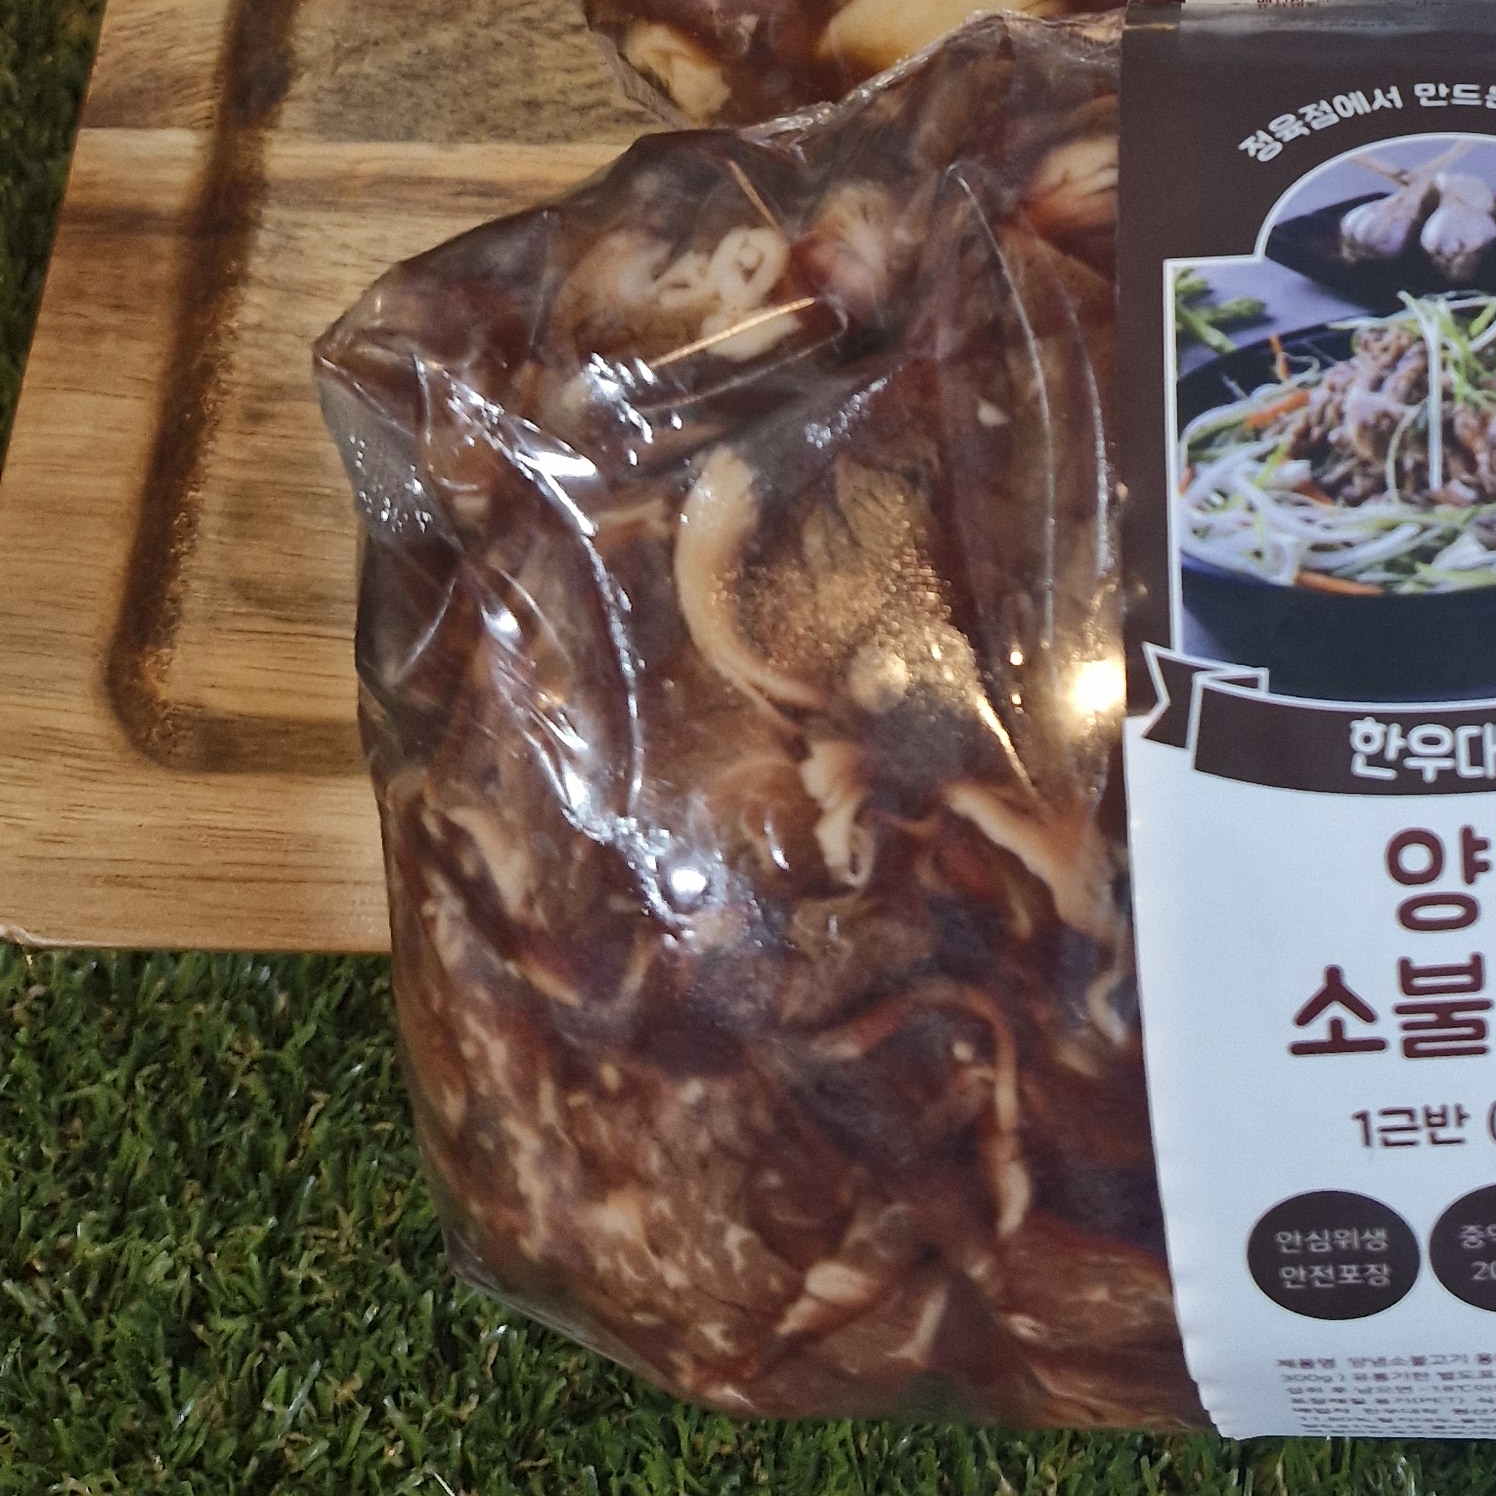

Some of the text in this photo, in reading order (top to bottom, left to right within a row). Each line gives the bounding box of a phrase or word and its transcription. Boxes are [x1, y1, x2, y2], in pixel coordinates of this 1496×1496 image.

[1238, 85, 1404, 163] 정육점에서
[1351, 1104, 1470, 1148] 1근반
[1274, 1227, 1389, 1254] 안심위생
[1278, 1263, 1392, 1289] 안전포장
